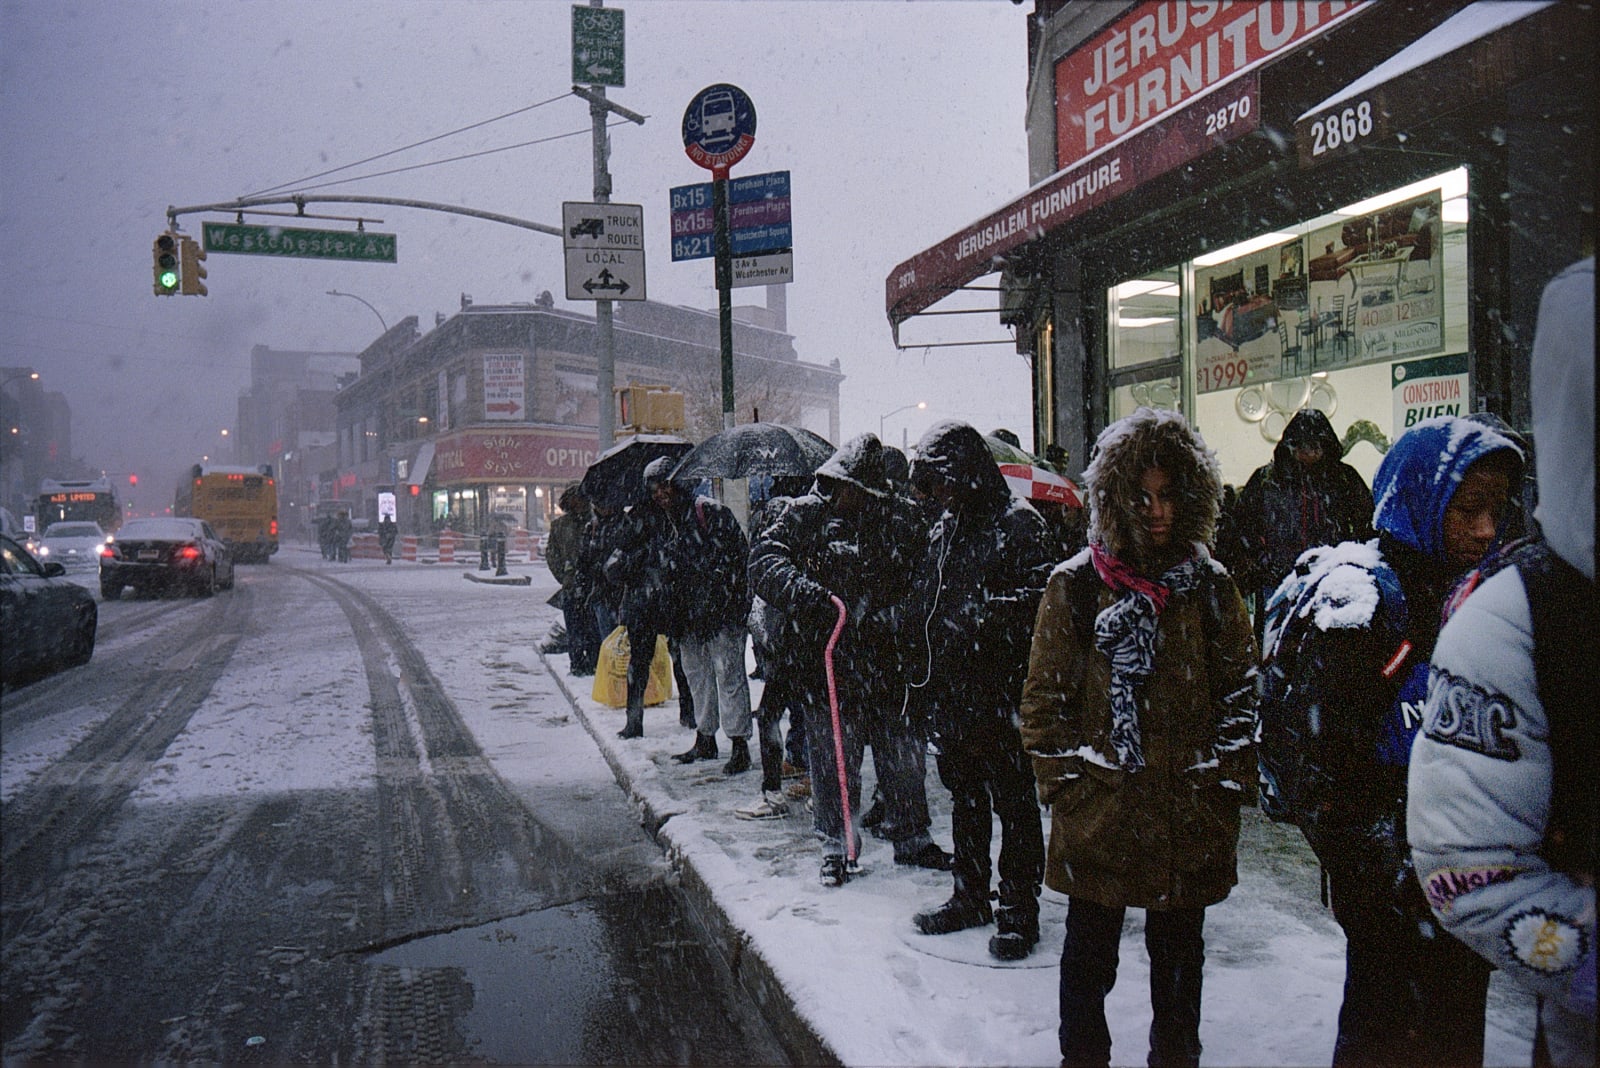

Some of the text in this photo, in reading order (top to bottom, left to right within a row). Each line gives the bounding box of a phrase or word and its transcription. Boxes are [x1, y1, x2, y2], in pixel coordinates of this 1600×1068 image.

[1084, 0, 1233, 97] JERUS
[1085, 0, 1366, 152] FURNITU
[1206, 95, 1251, 136] 2870
[1310, 101, 1373, 157] 2868
[691, 138, 749, 166] NO STANDING
[734, 175, 785, 192] Fordham Plaza
[674, 187, 705, 209] Bx15
[734, 202, 786, 217] Fordham Plaza
[954, 157, 1122, 262] JERUSALEM FURNITURE
[607, 215, 639, 227] TRUCK
[675, 212, 706, 233] Bx15
[208, 228, 392, 257] Westchester Av
[607, 233, 639, 246] ROUTE
[735, 225, 789, 242] Westchester Square
[675, 236, 711, 258] Bx21
[585, 252, 625, 265] LOCAL
[741, 259, 750, 269] Av
[751, 259, 758, 268] &
[735, 265, 789, 280] Westchester Av
[898, 270, 916, 289] 2870
[1362, 310, 1379, 328] 40
[1395, 302, 1410, 321] 12
[1196, 358, 1248, 391] $1999
[1403, 378, 1461, 405] CONSTRUYA
[1404, 403, 1461, 428] BUEN
[483, 436, 521, 449] Sight
[757, 447, 778, 459] W
[484, 459, 522, 474] Style
[546, 447, 600, 467] OPTIC
